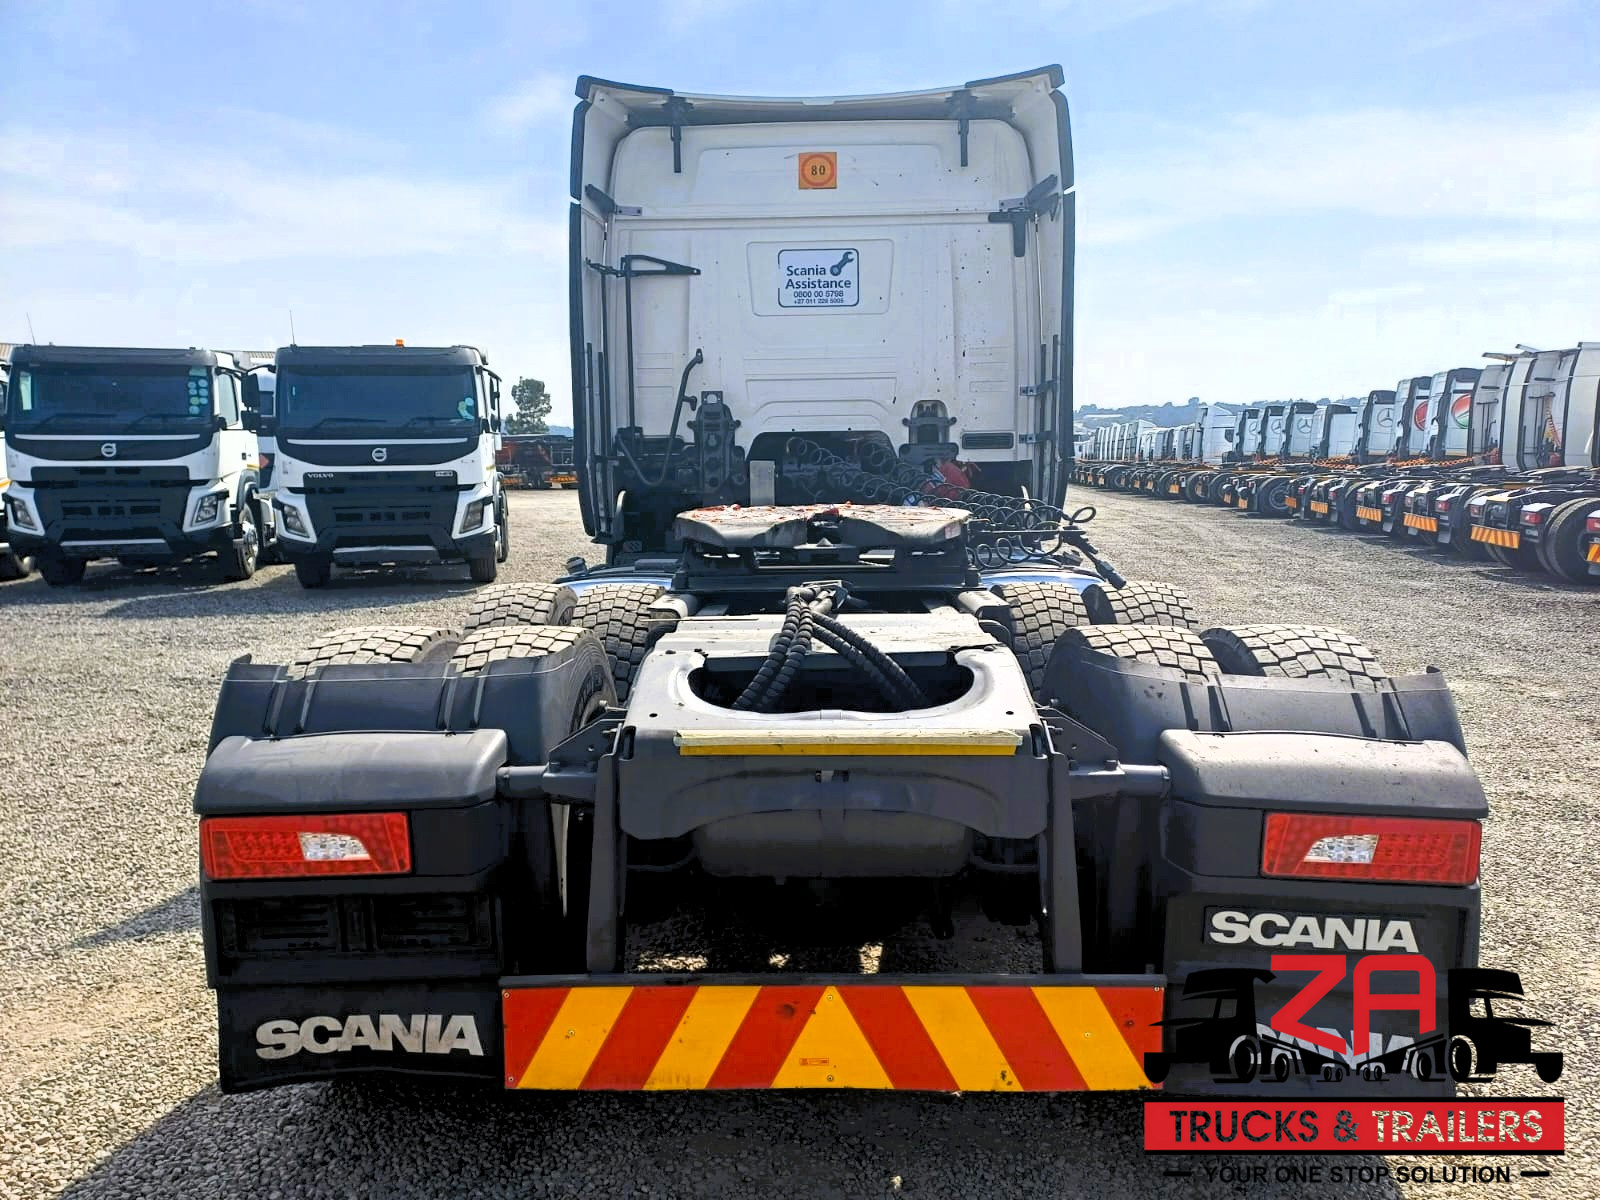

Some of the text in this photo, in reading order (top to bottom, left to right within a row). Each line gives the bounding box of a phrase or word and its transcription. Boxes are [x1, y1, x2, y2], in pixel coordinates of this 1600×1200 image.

[811, 164, 826, 176] 80
[786, 265, 826, 277] Scania
[785, 278, 852, 289] Assistance
[794, 290, 812, 298] 0800
[814, 290, 824, 298] 00
[1209, 910, 1420, 953] SCANIA
[255, 1013, 484, 1060] SCANIA
